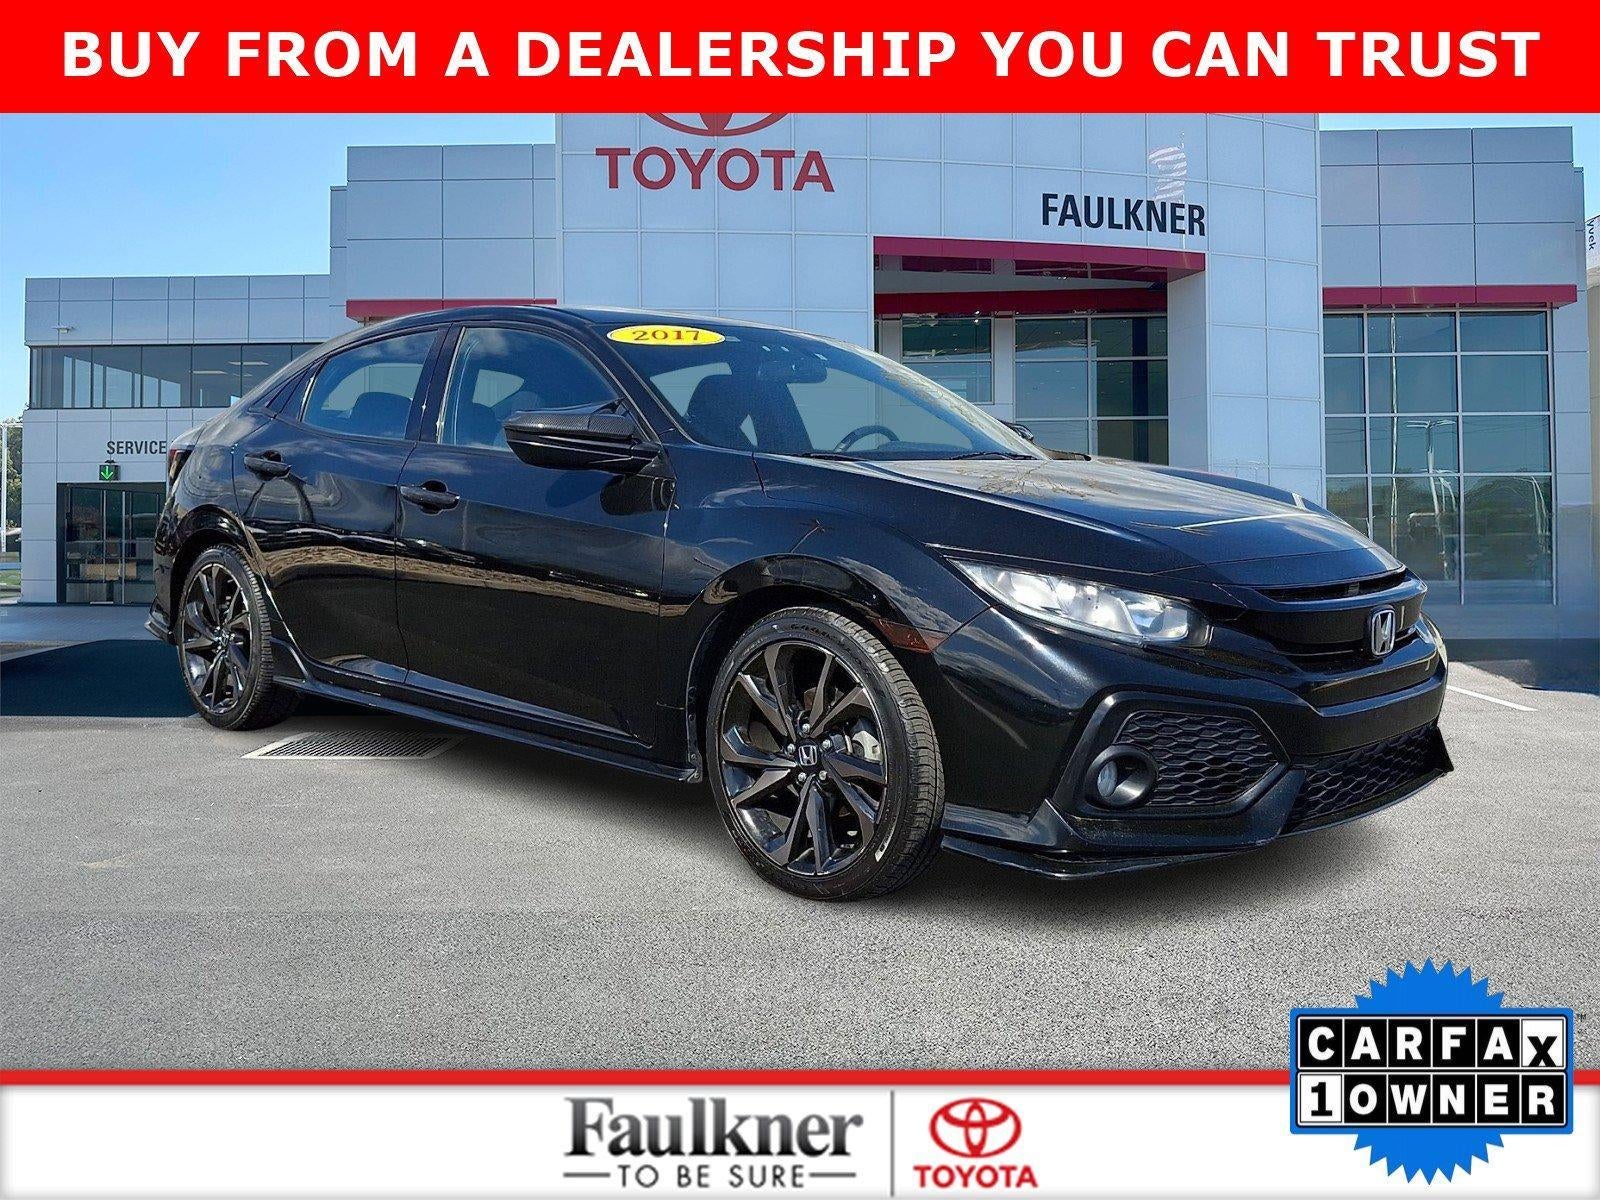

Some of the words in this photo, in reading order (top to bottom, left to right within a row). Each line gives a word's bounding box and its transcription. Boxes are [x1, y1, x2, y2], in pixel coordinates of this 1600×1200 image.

[596, 147, 834, 192] TOYOTA
[1042, 193, 1206, 237] FAULKNER
[632, 329, 700, 341] 2017
[107, 440, 167, 455] SERVICE
